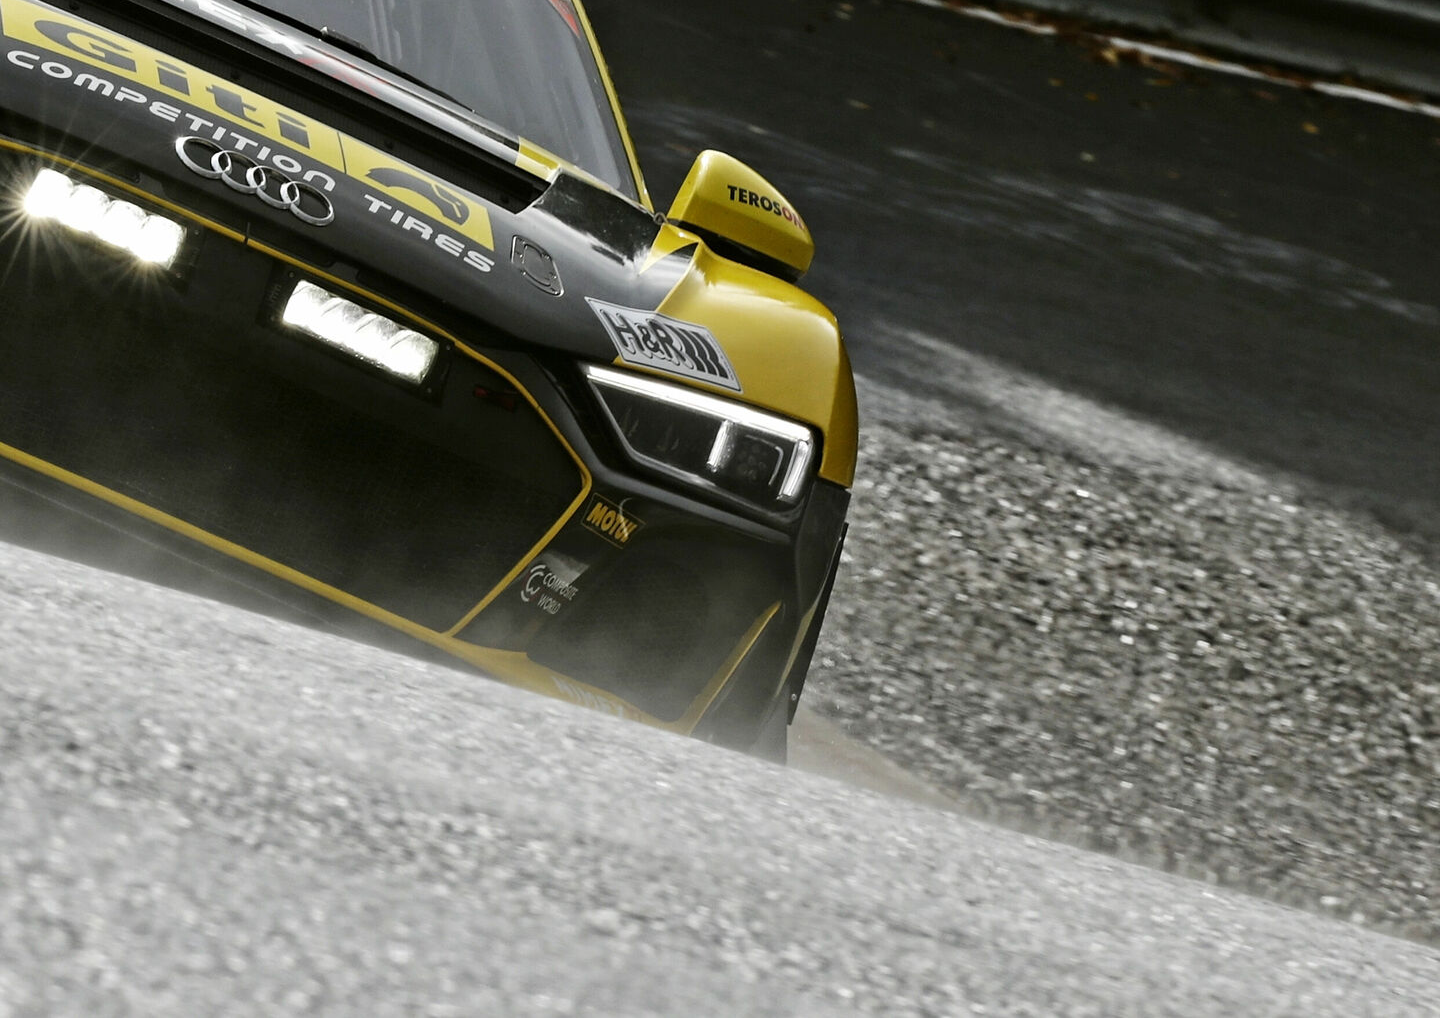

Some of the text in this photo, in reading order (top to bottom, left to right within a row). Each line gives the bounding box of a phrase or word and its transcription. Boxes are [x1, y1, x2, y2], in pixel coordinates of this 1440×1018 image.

[34, 18, 326, 154] Giti
[6, 49, 495, 273] COMPETITION TIRES
[727, 184, 806, 232] TEROSON
[599, 308, 695, 370] H&R
